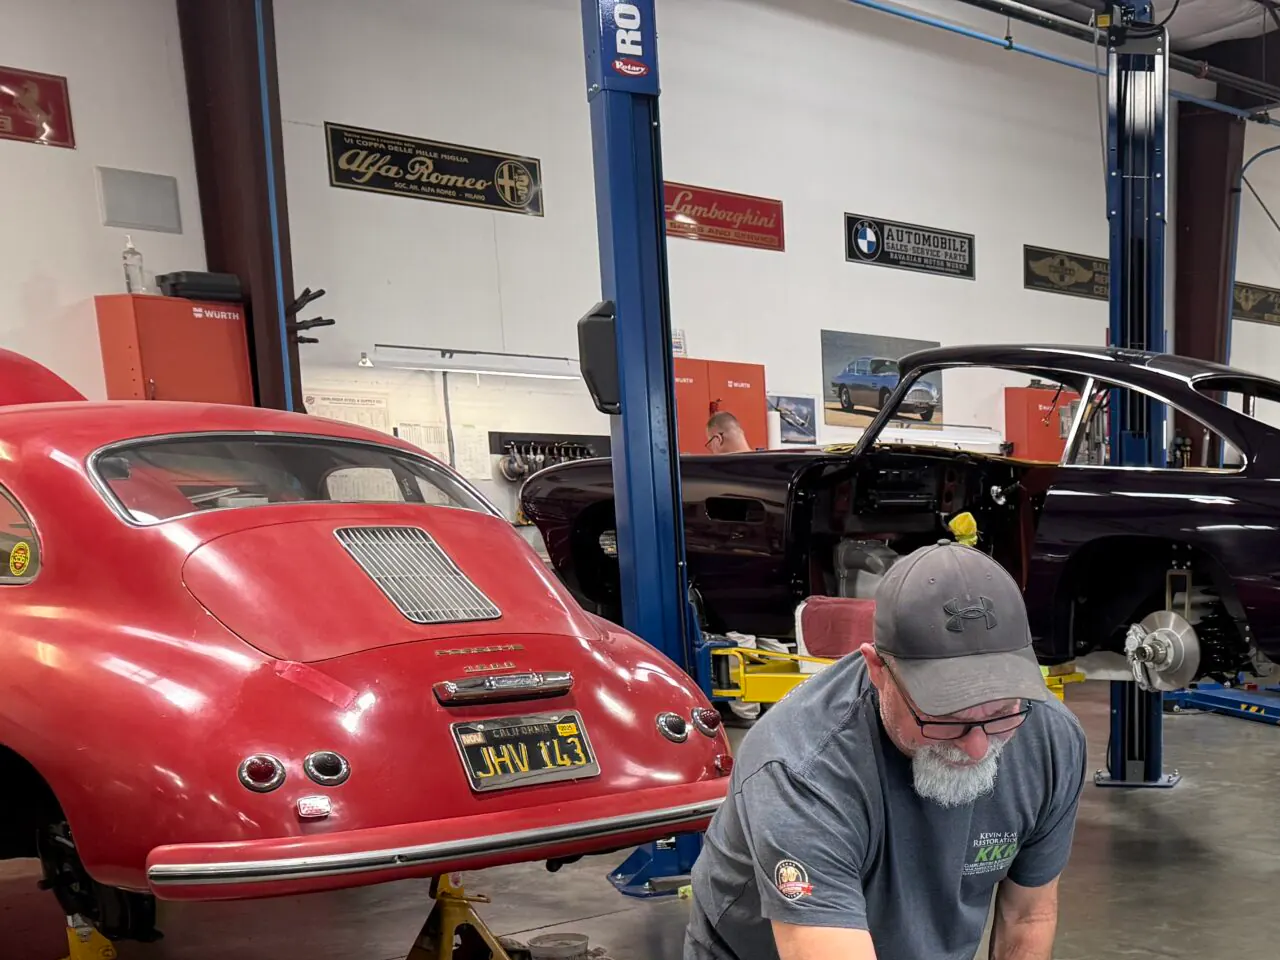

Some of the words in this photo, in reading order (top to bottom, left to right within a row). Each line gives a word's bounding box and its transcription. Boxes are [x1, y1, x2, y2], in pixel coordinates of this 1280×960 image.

[614, 1, 642, 56] RO
[614, 60, 646, 75] Rotary
[356, 139, 386, 149] COPPA
[388, 144, 413, 154] DELLE
[415, 149, 439, 158] MILLE
[338, 149, 404, 183] Alfa
[406, 156, 493, 191] Romeo
[664, 190, 777, 229] Lamborghini
[886, 228, 967, 253] AUTOMOBILE
[886, 242, 909, 253] SALES
[912, 246, 941, 258] SERVICE
[944, 251, 967, 262] PARTS
[492, 723, 551, 738] CALIFORNIA
[477, 742, 529, 777] JHV
[537, 737, 587, 768] 143
[979, 832, 1002, 840] KEVIN
